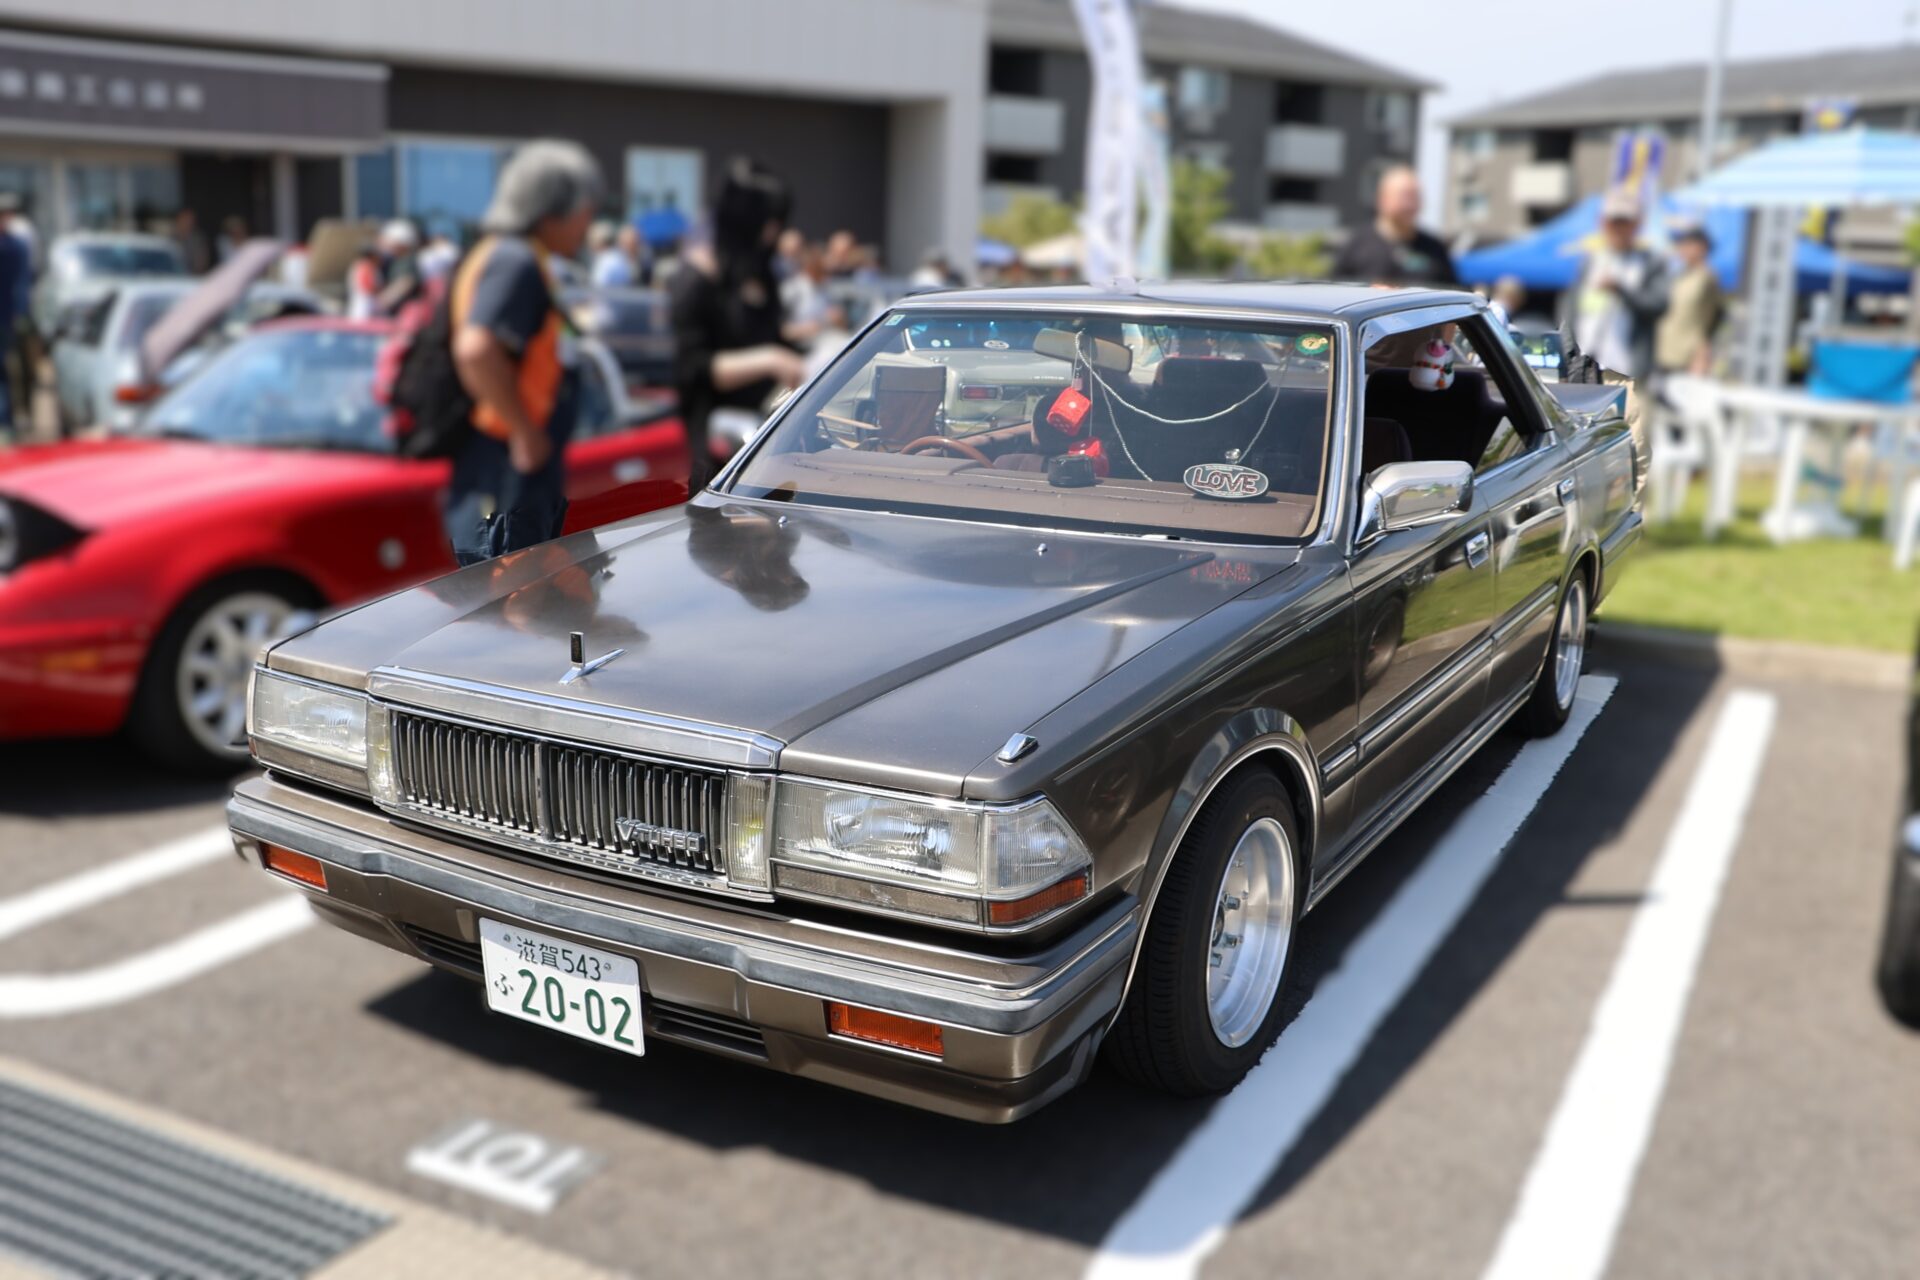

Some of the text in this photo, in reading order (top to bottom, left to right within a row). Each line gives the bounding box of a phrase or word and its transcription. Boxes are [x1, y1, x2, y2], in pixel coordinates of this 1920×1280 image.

[1192, 467, 1260, 494] LOVE
[494, 968, 634, 1046] ふ 20-02
